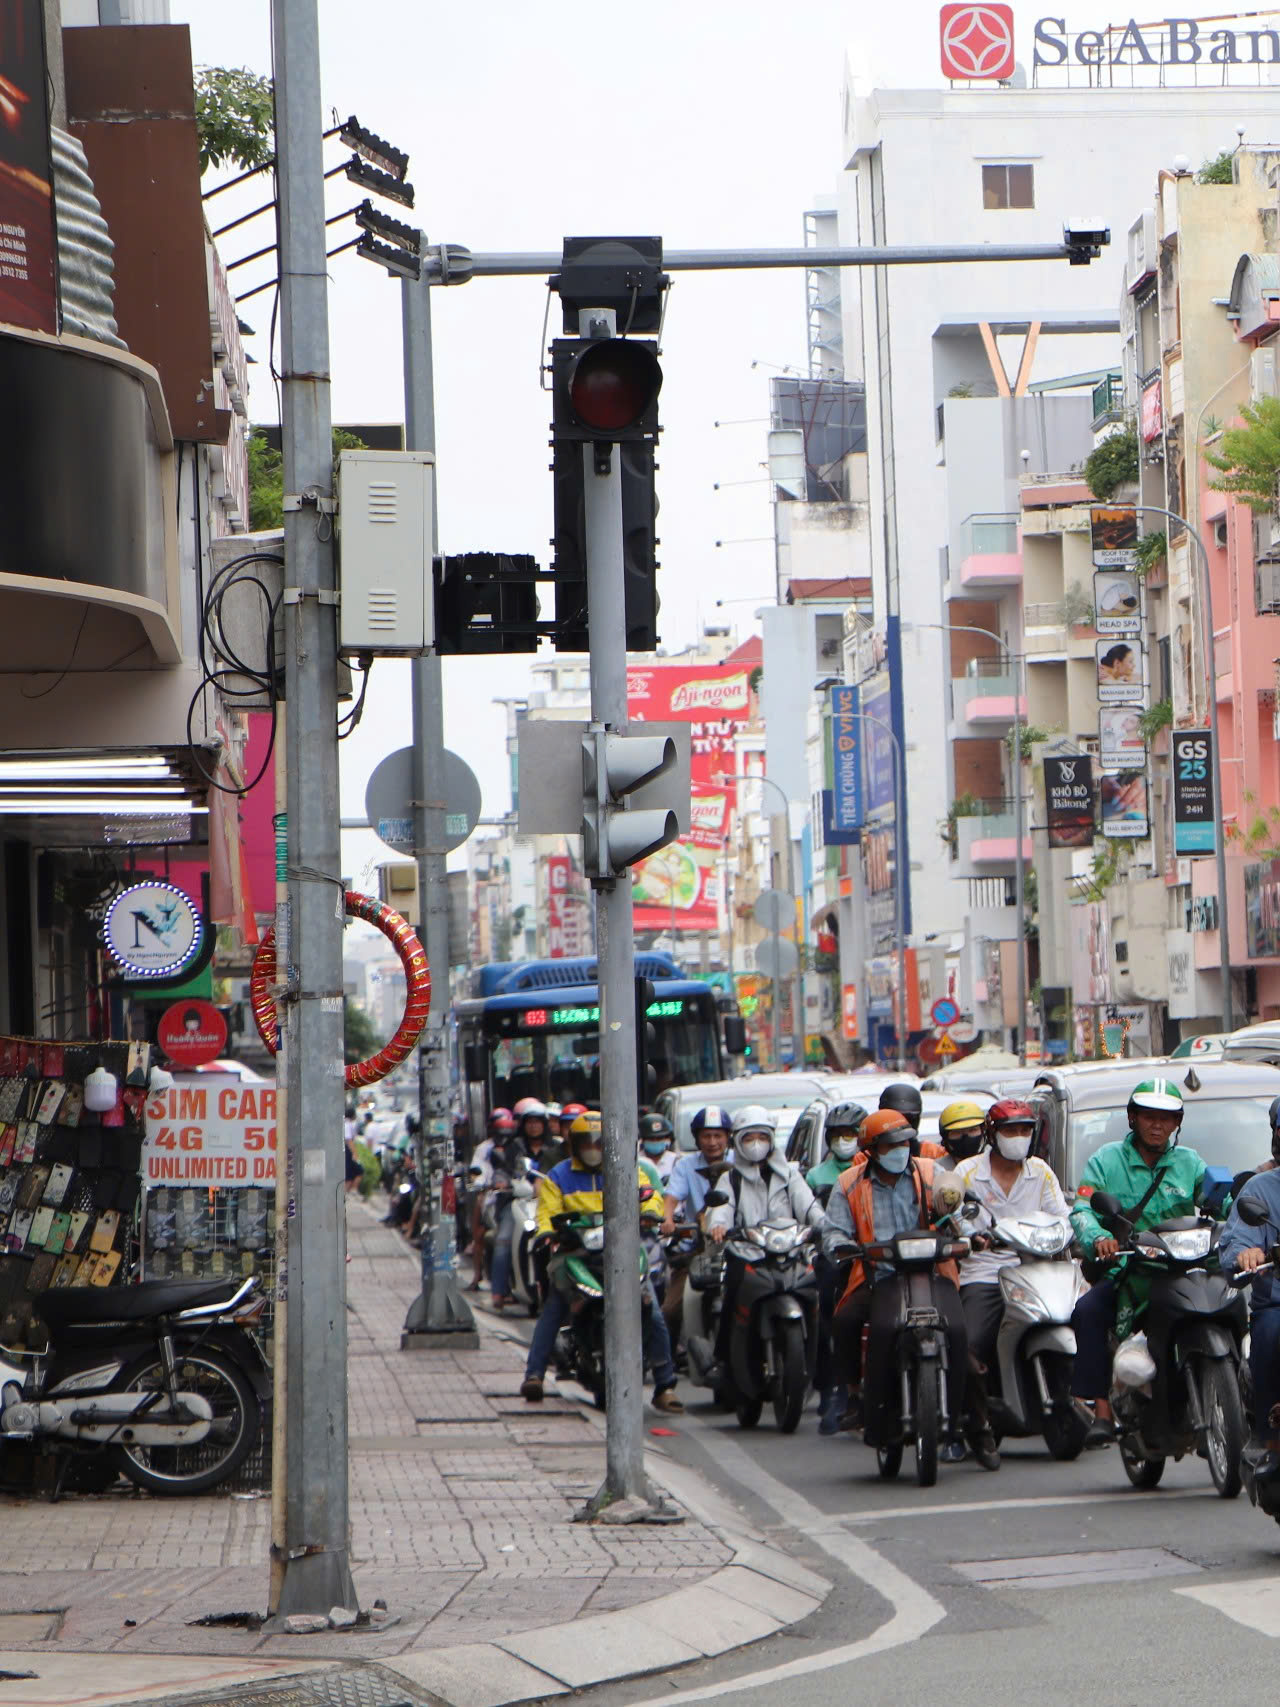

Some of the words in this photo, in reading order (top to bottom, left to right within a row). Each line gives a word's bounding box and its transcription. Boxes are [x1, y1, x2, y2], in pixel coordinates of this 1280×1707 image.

[1177, 740, 1208, 760] GS
[1179, 760, 1207, 780] 25
[147, 1088, 207, 1121] SIM
[154, 1126, 203, 1151] 4G
[148, 1156, 248, 1180] UNLIMITED
